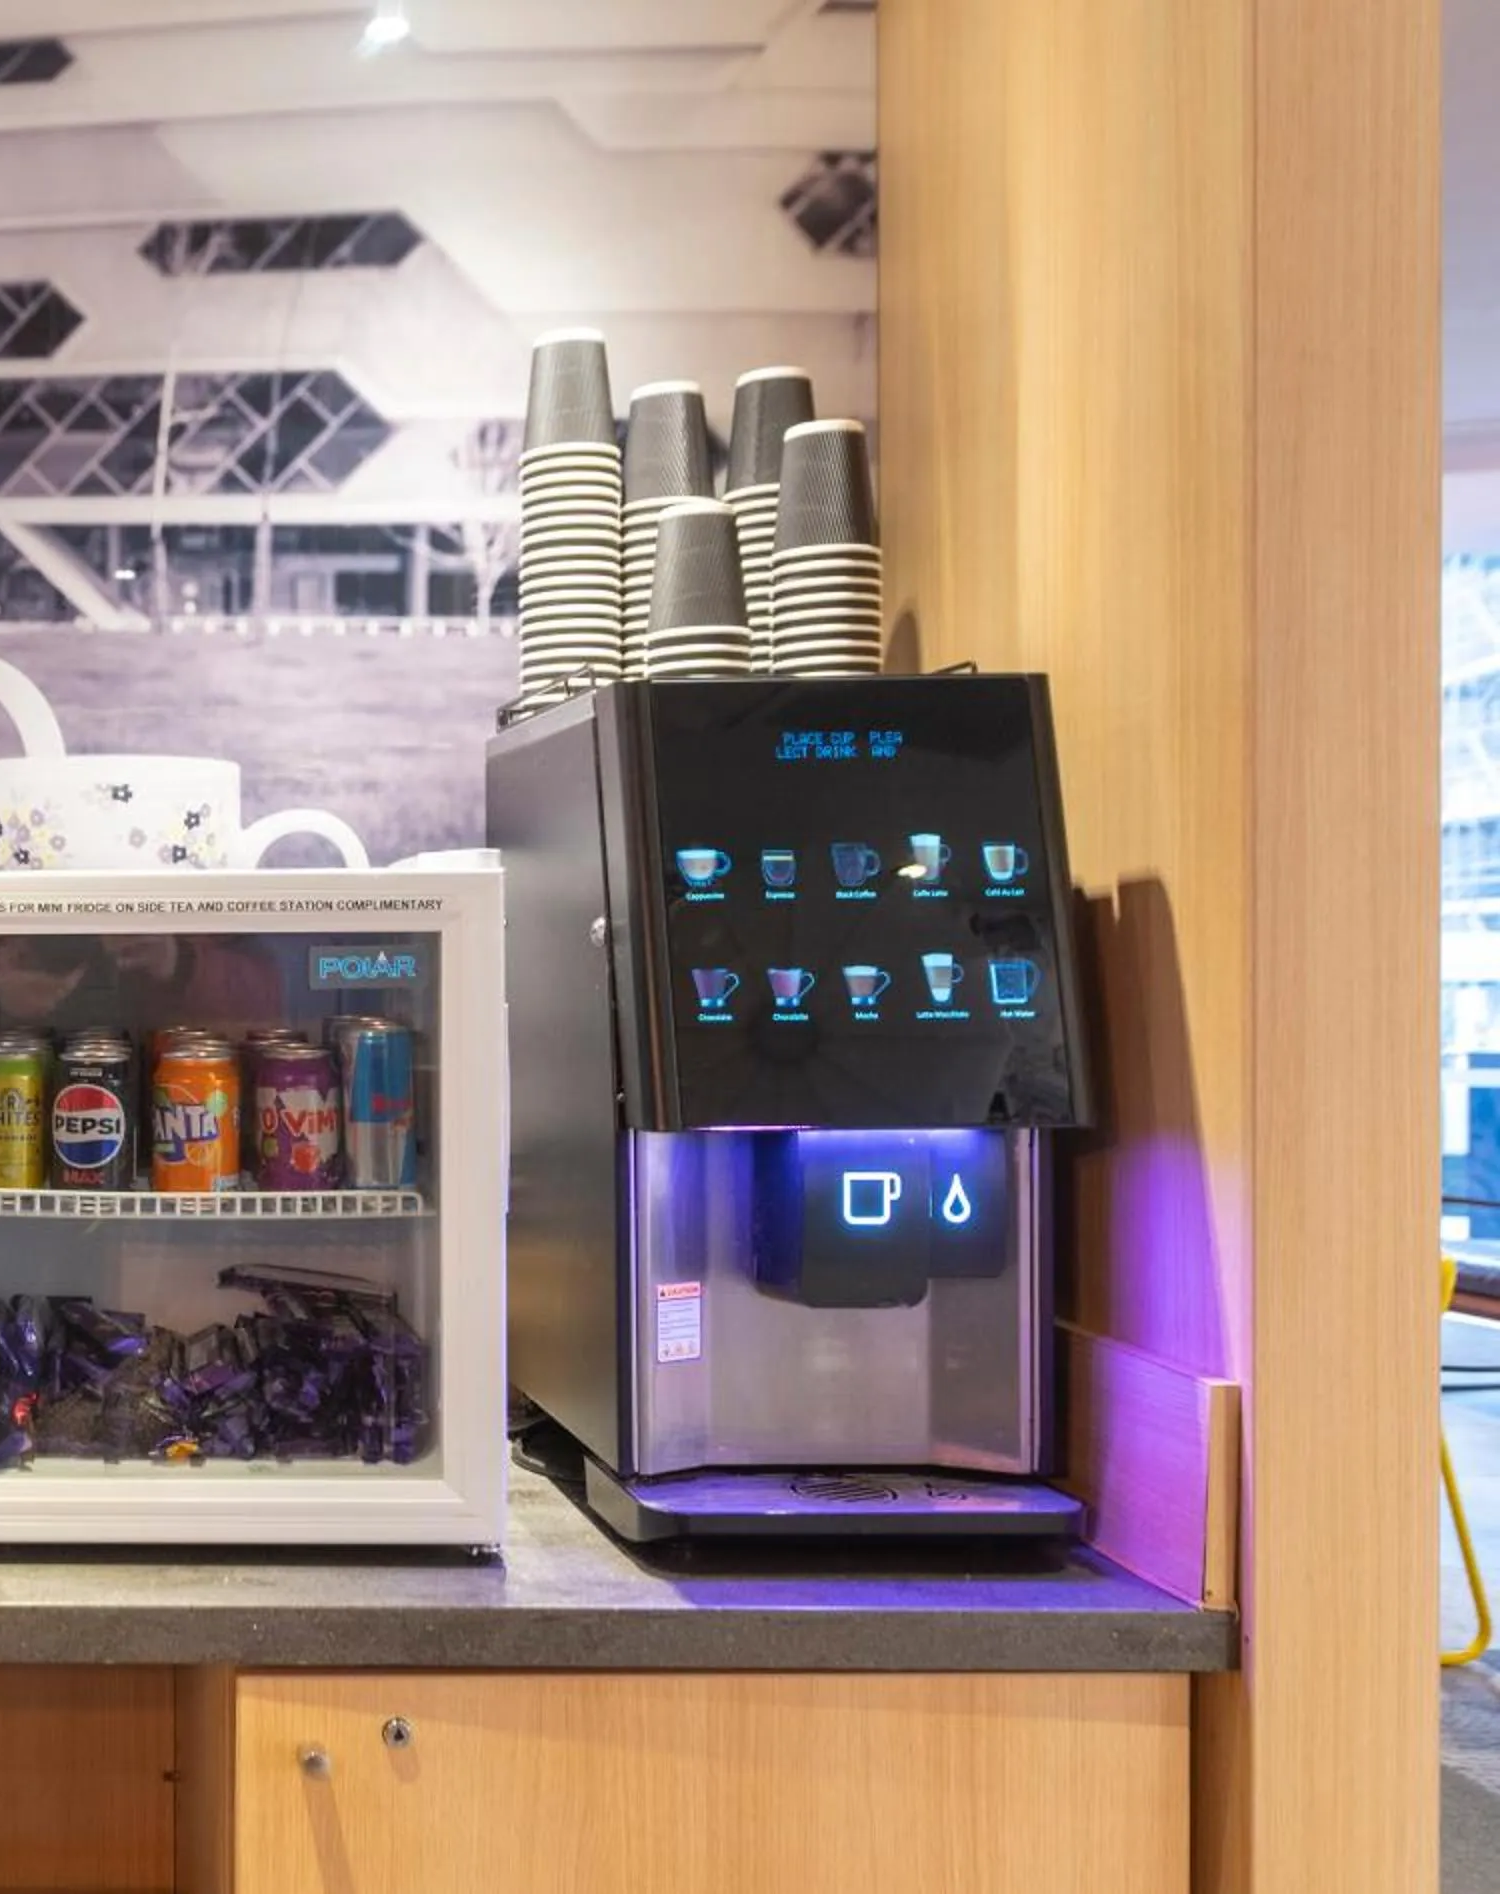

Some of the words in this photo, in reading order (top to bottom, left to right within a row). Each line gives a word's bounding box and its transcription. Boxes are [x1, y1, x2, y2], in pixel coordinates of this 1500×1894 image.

[782, 731, 823, 745] PLACE
[829, 731, 855, 744] CUP
[9, 901, 35, 914] FOR
[67, 901, 112, 914] FRIDGE
[115, 901, 135, 913] ON
[137, 901, 165, 913] SIDE
[170, 901, 194, 913] TEA
[197, 901, 223, 913] AND
[226, 901, 278, 913] COFFEE
[280, 900, 333, 912] STATION
[336, 899, 443, 912] COMPLIMENTARY
[318, 951, 417, 979] POLAR
[55, 1117, 120, 1135] PEPSI
[152, 1103, 219, 1141] ANTA
